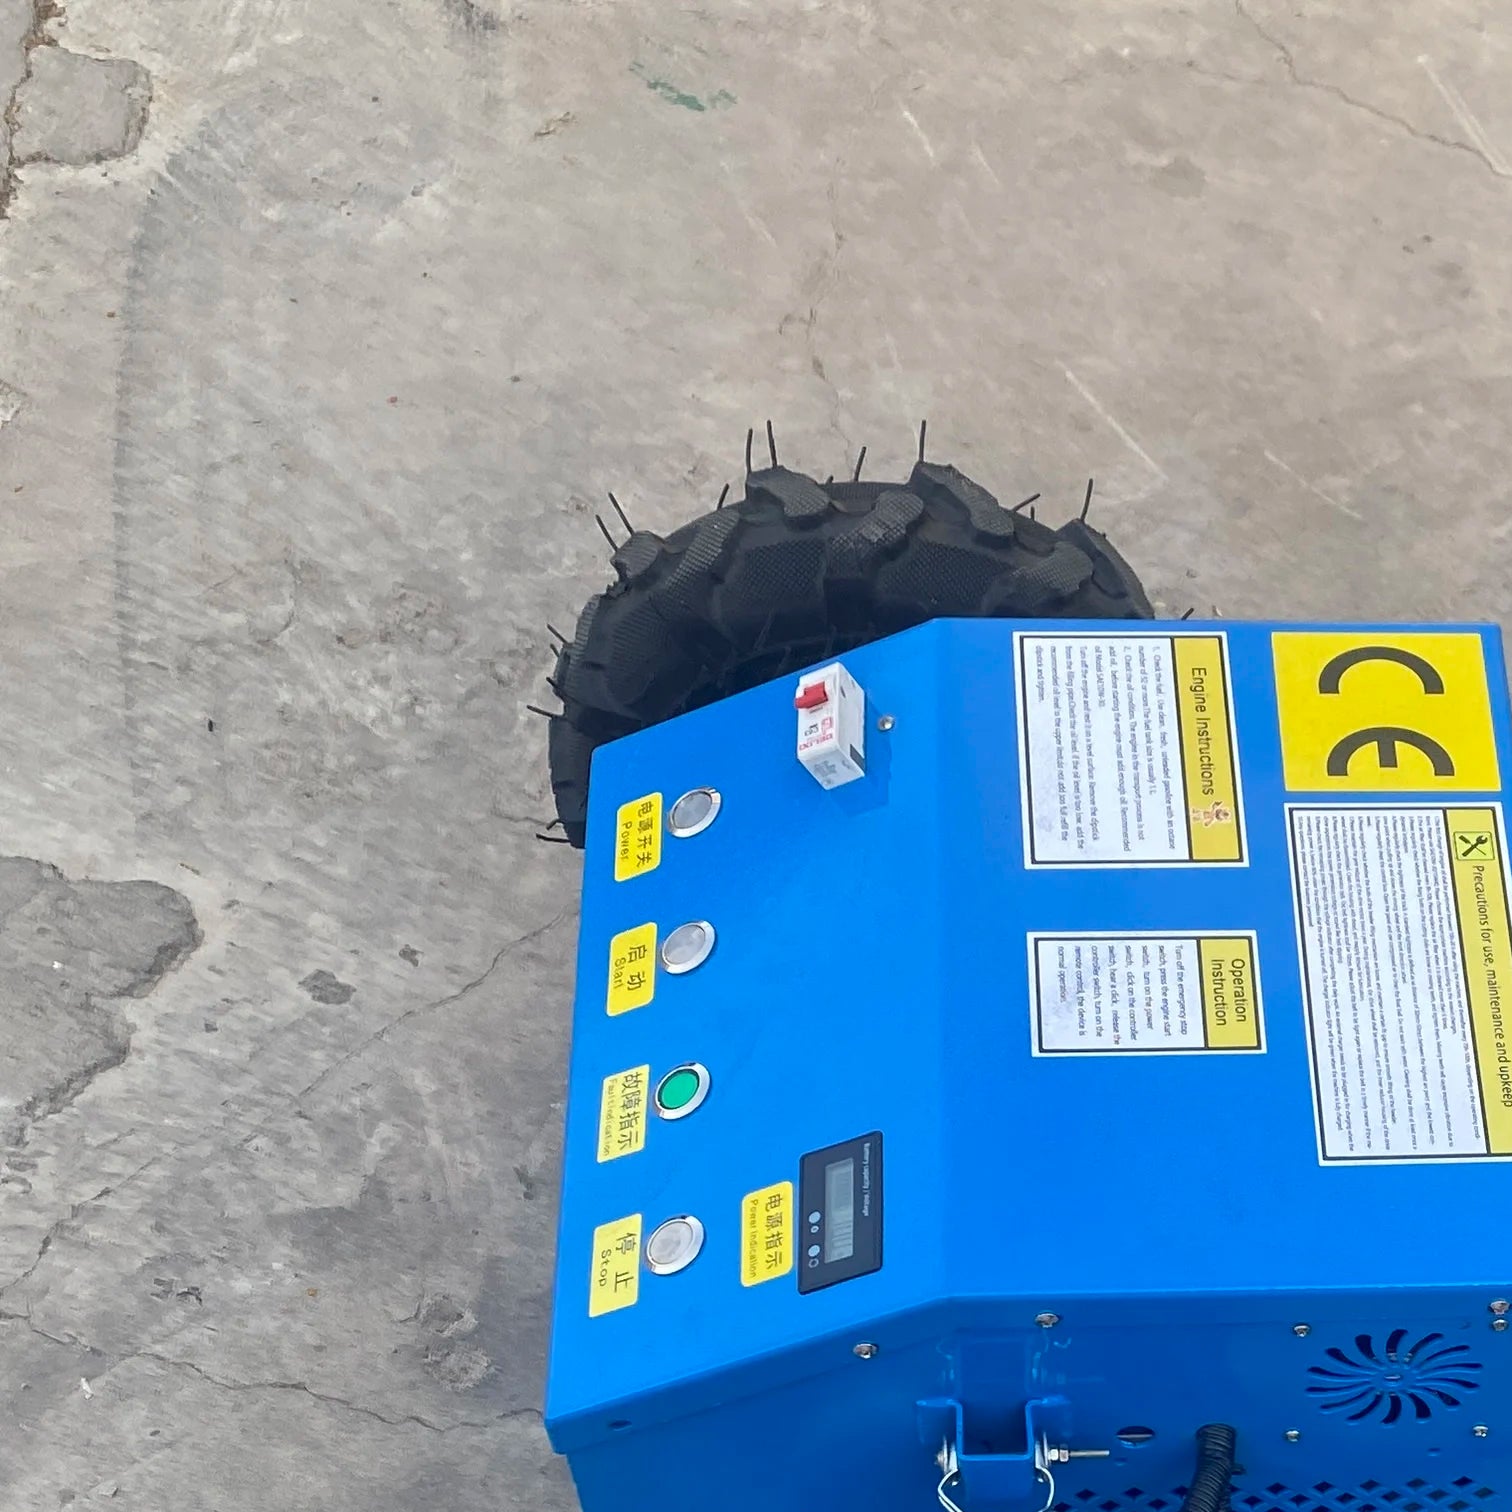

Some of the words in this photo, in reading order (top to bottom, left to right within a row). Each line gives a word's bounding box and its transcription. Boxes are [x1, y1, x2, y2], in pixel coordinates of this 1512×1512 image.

[1190, 667, 1209, 712] Engine
[1318, 646, 1455, 776] CE
[1196, 717, 1216, 795] Instructions
[620, 821, 632, 860] Power
[636, 802, 653, 868] 电源开关
[1472, 866, 1492, 925] Precautions
[1480, 929, 1495, 943] for
[1481, 946, 1494, 967] use,
[627, 945, 647, 991] 启动
[1211, 959, 1228, 1026] Instruction
[1228, 958, 1248, 1022] Operation
[1486, 970, 1507, 1039] maintenance
[1495, 1042, 1511, 1063] and
[618, 1072, 642, 1150] 故障指示
[749, 1199, 759, 1228] Power
[765, 1194, 782, 1270] 电源指示
[598, 1249, 612, 1287] Stop
[614, 1232, 637, 1293] 停止
